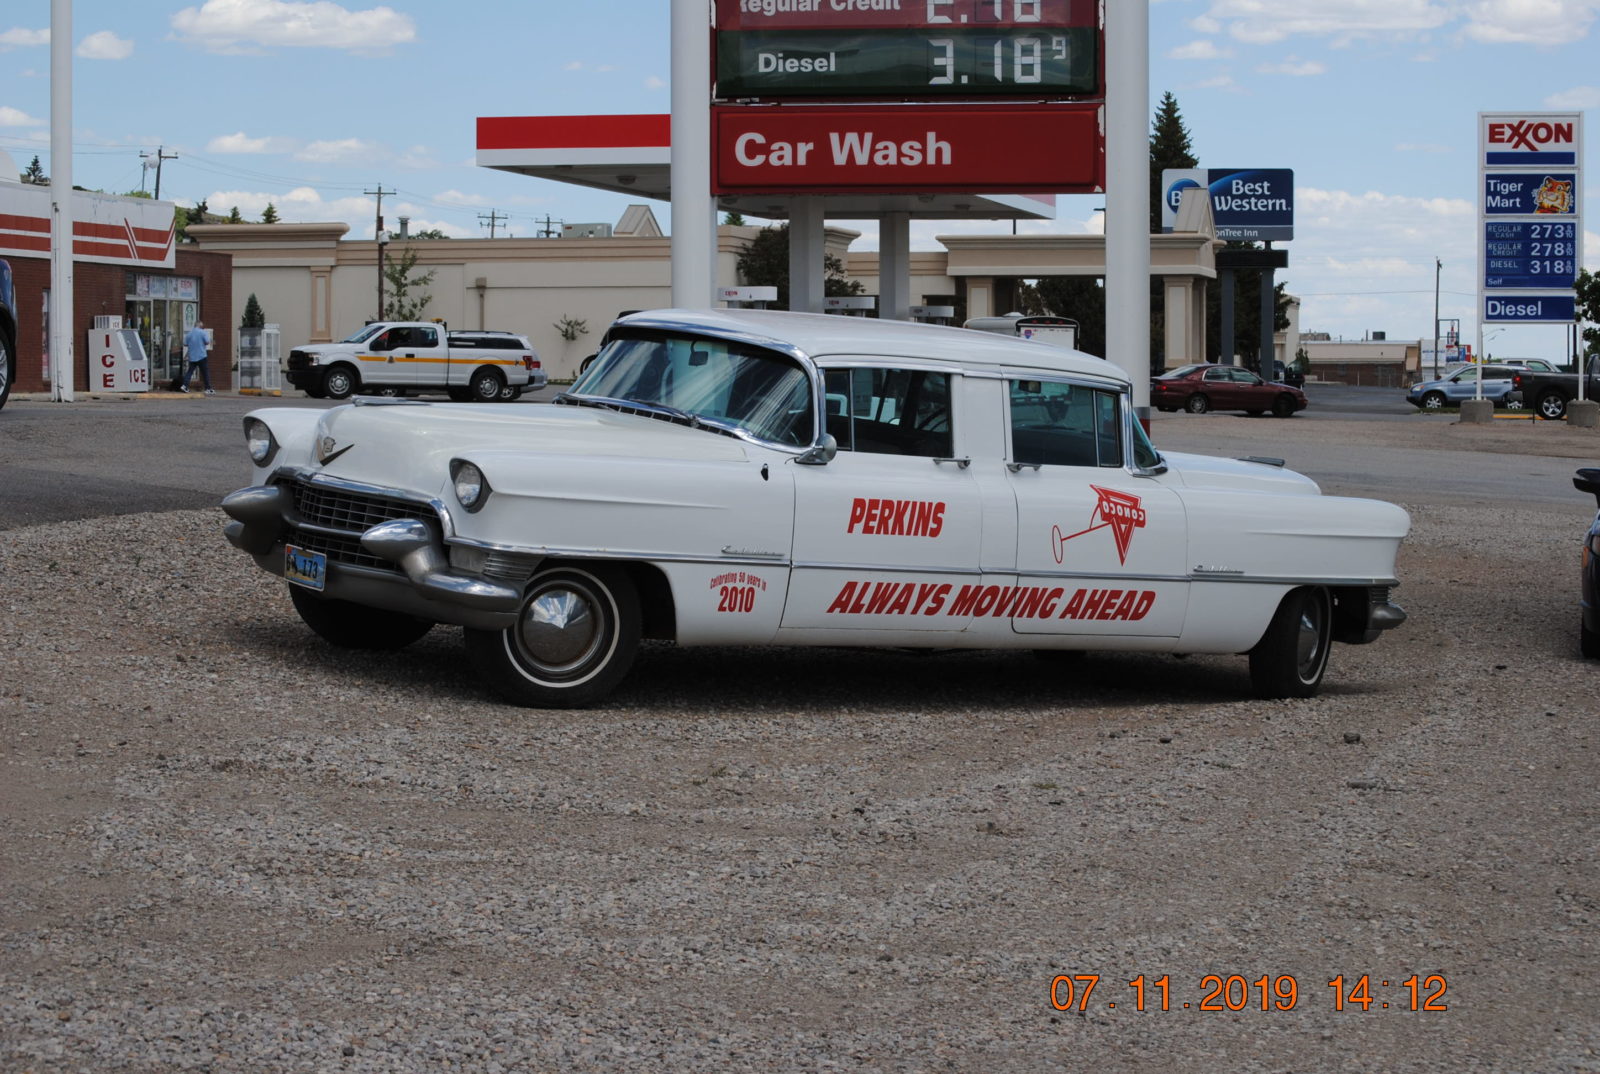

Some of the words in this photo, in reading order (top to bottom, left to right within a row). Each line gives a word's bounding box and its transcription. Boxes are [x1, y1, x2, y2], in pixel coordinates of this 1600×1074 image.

[758, 52, 836, 73] Diesel
[1488, 119, 1573, 151] EXXON
[734, 132, 814, 167] Car
[829, 132, 952, 167] Wash
[1231, 179, 1271, 195] Best
[1487, 180, 1523, 195] Tiger
[1487, 196, 1521, 208] Mart
[1244, 228, 1258, 237] Inn
[1530, 224, 1564, 239] 273
[1530, 242, 1564, 256] 278
[1490, 260, 1519, 268] DIESEL
[1530, 260, 1564, 274] 318
[1487, 300, 1542, 316] Diesel
[101, 334, 115, 388] ICE
[129, 368, 146, 383] ICE
[847, 497, 946, 538] PERKINS
[718, 585, 755, 613] 2010
[826, 581, 953, 616] ALWAYS
[947, 584, 1064, 619] MOVING
[1059, 588, 1156, 621] AHEAD
